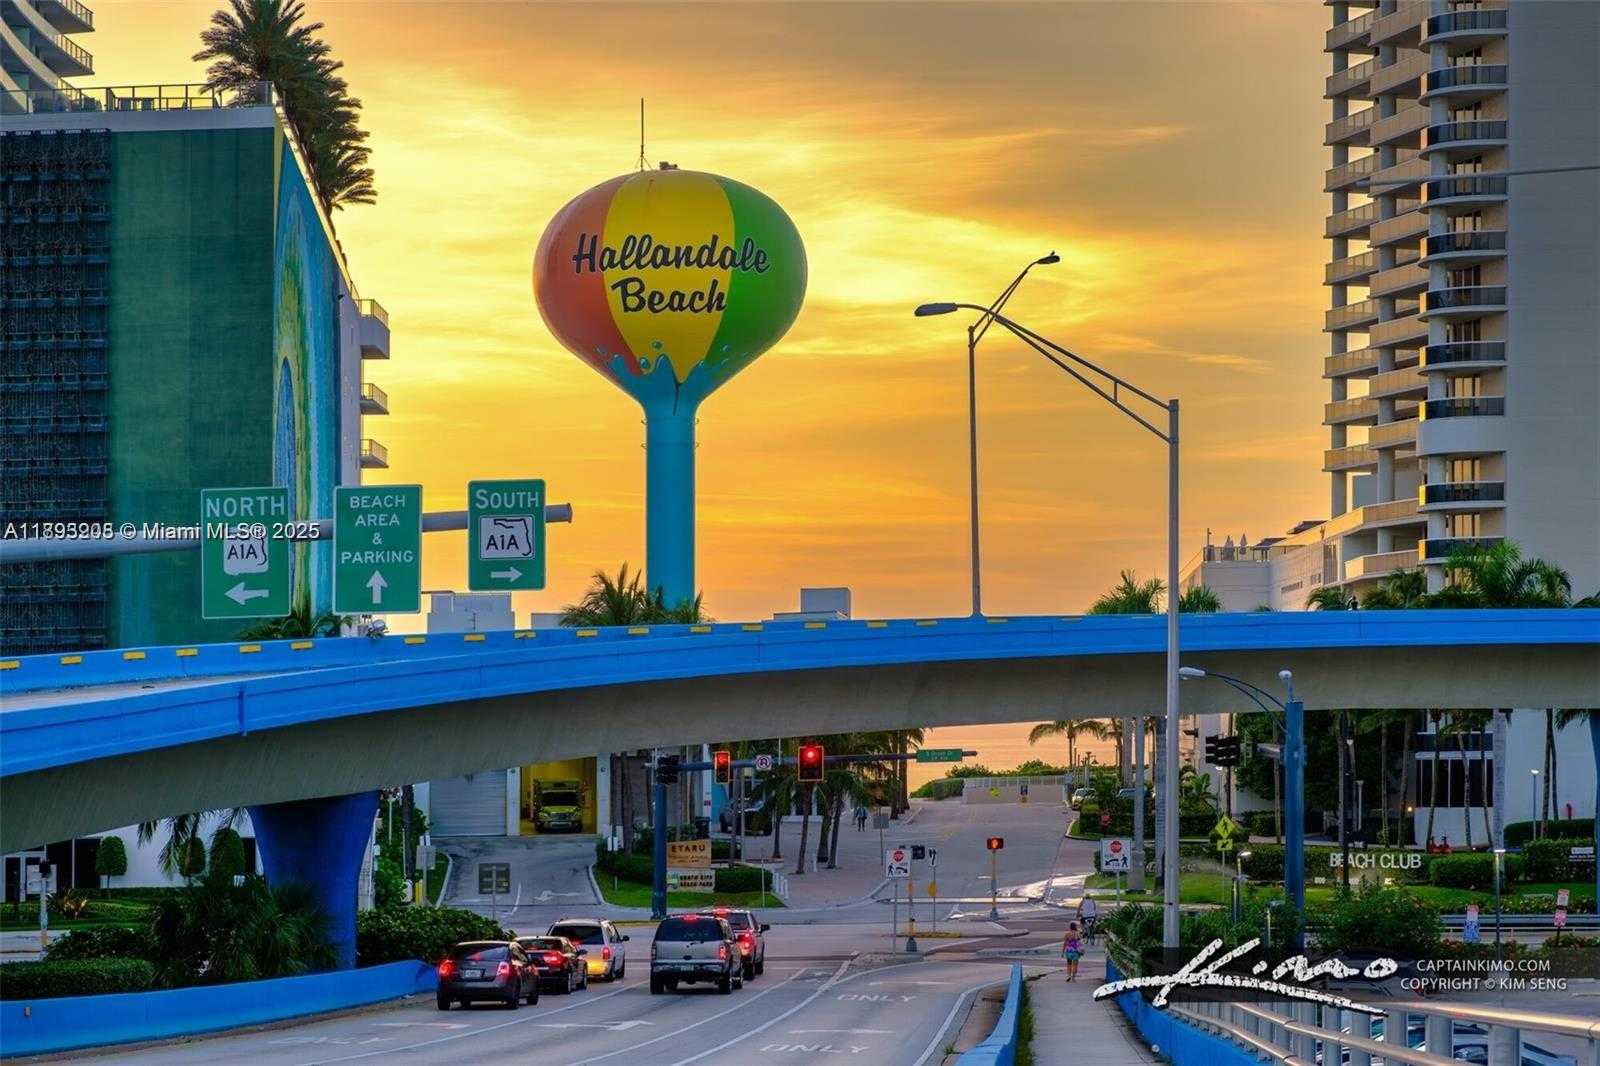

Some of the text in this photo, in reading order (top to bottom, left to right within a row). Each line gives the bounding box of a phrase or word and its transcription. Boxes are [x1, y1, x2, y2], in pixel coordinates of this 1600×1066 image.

[572, 233, 771, 274] Hallandale
[611, 277, 728, 314] Beach
[206, 494, 286, 519] NORTH
[350, 495, 406, 509] BEACH
[475, 489, 540, 510] SOUTH
[354, 514, 401, 528] AREA
[372, 531, 383, 546] &
[485, 534, 520, 552] A1A
[227, 544, 258, 561] A1A
[341, 550, 414, 565] PARKING
[1330, 853, 1421, 869] BEACH CLUB
[760, 1043, 870, 1054] ONLY
